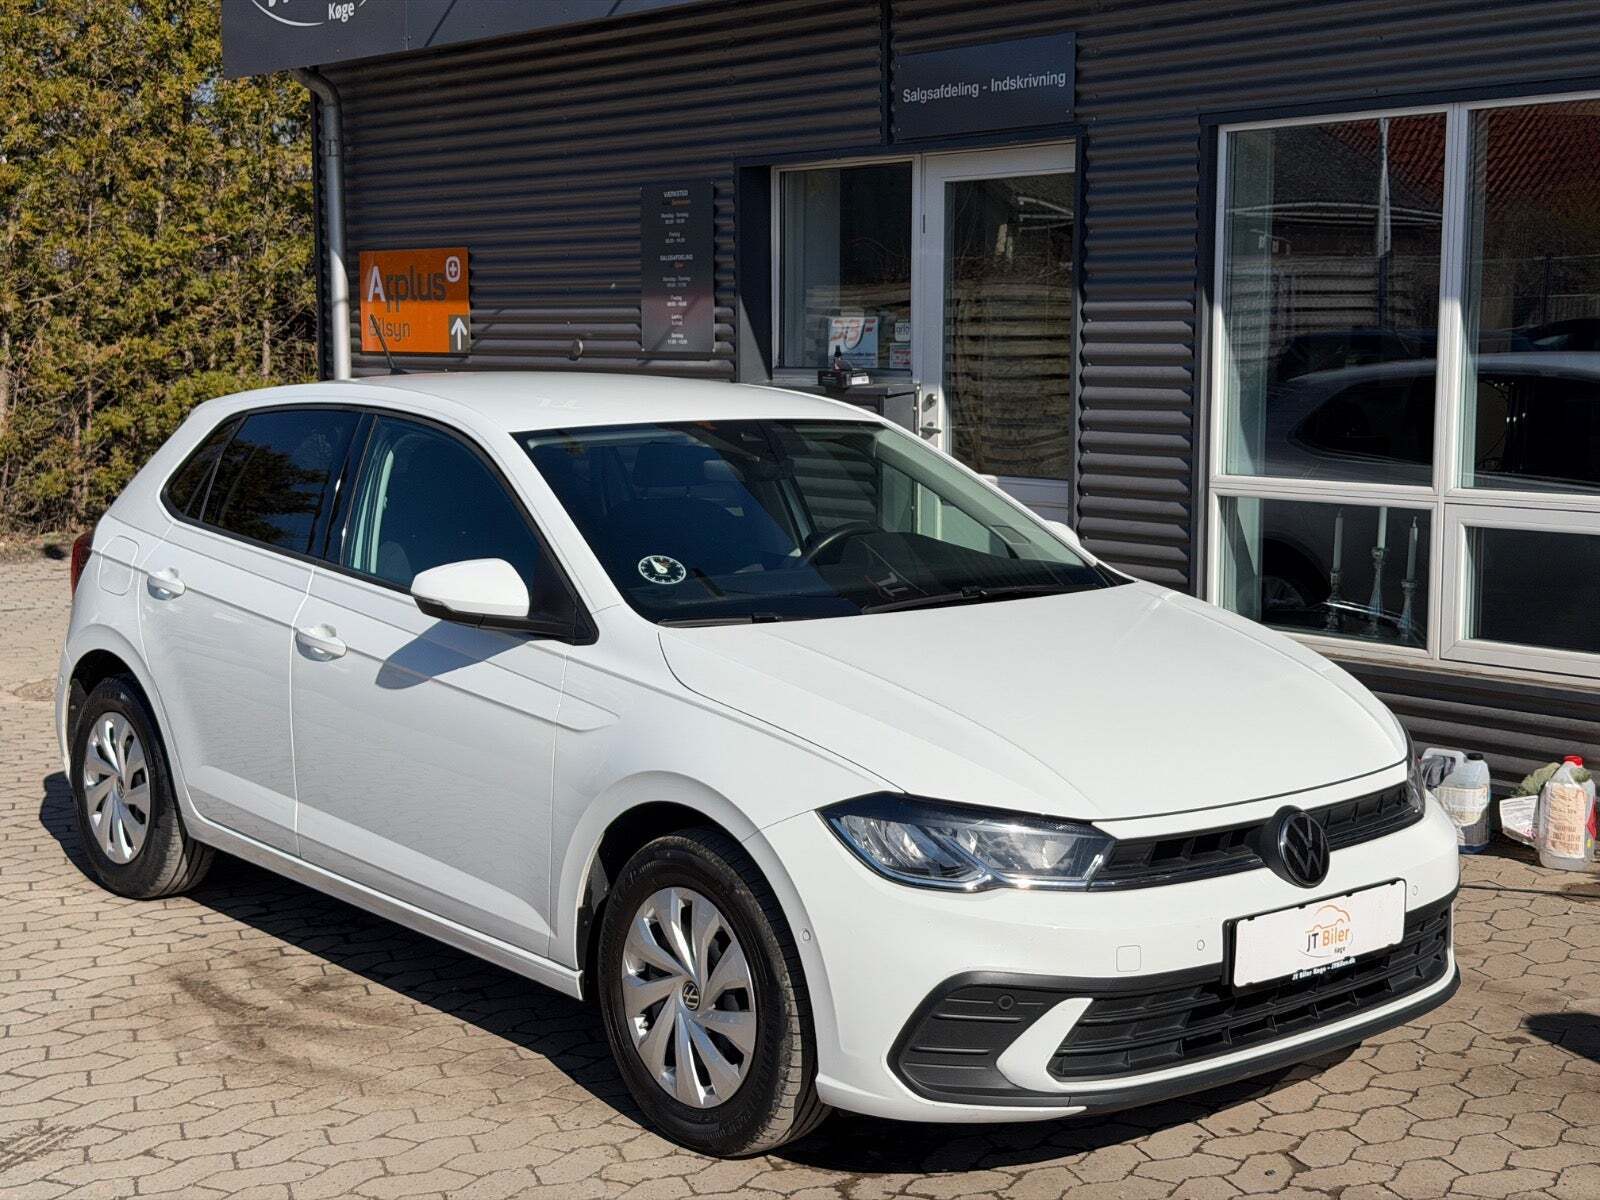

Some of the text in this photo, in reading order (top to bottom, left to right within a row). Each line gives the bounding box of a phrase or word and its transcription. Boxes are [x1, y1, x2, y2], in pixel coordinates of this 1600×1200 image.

[328, 3, 354, 23] Køge
[903, 82, 979, 103] Salgsafdeling
[991, 71, 1066, 92] Indskrivning
[369, 317, 411, 341] Blsyn
[1306, 928, 1350, 952] JT Biler
